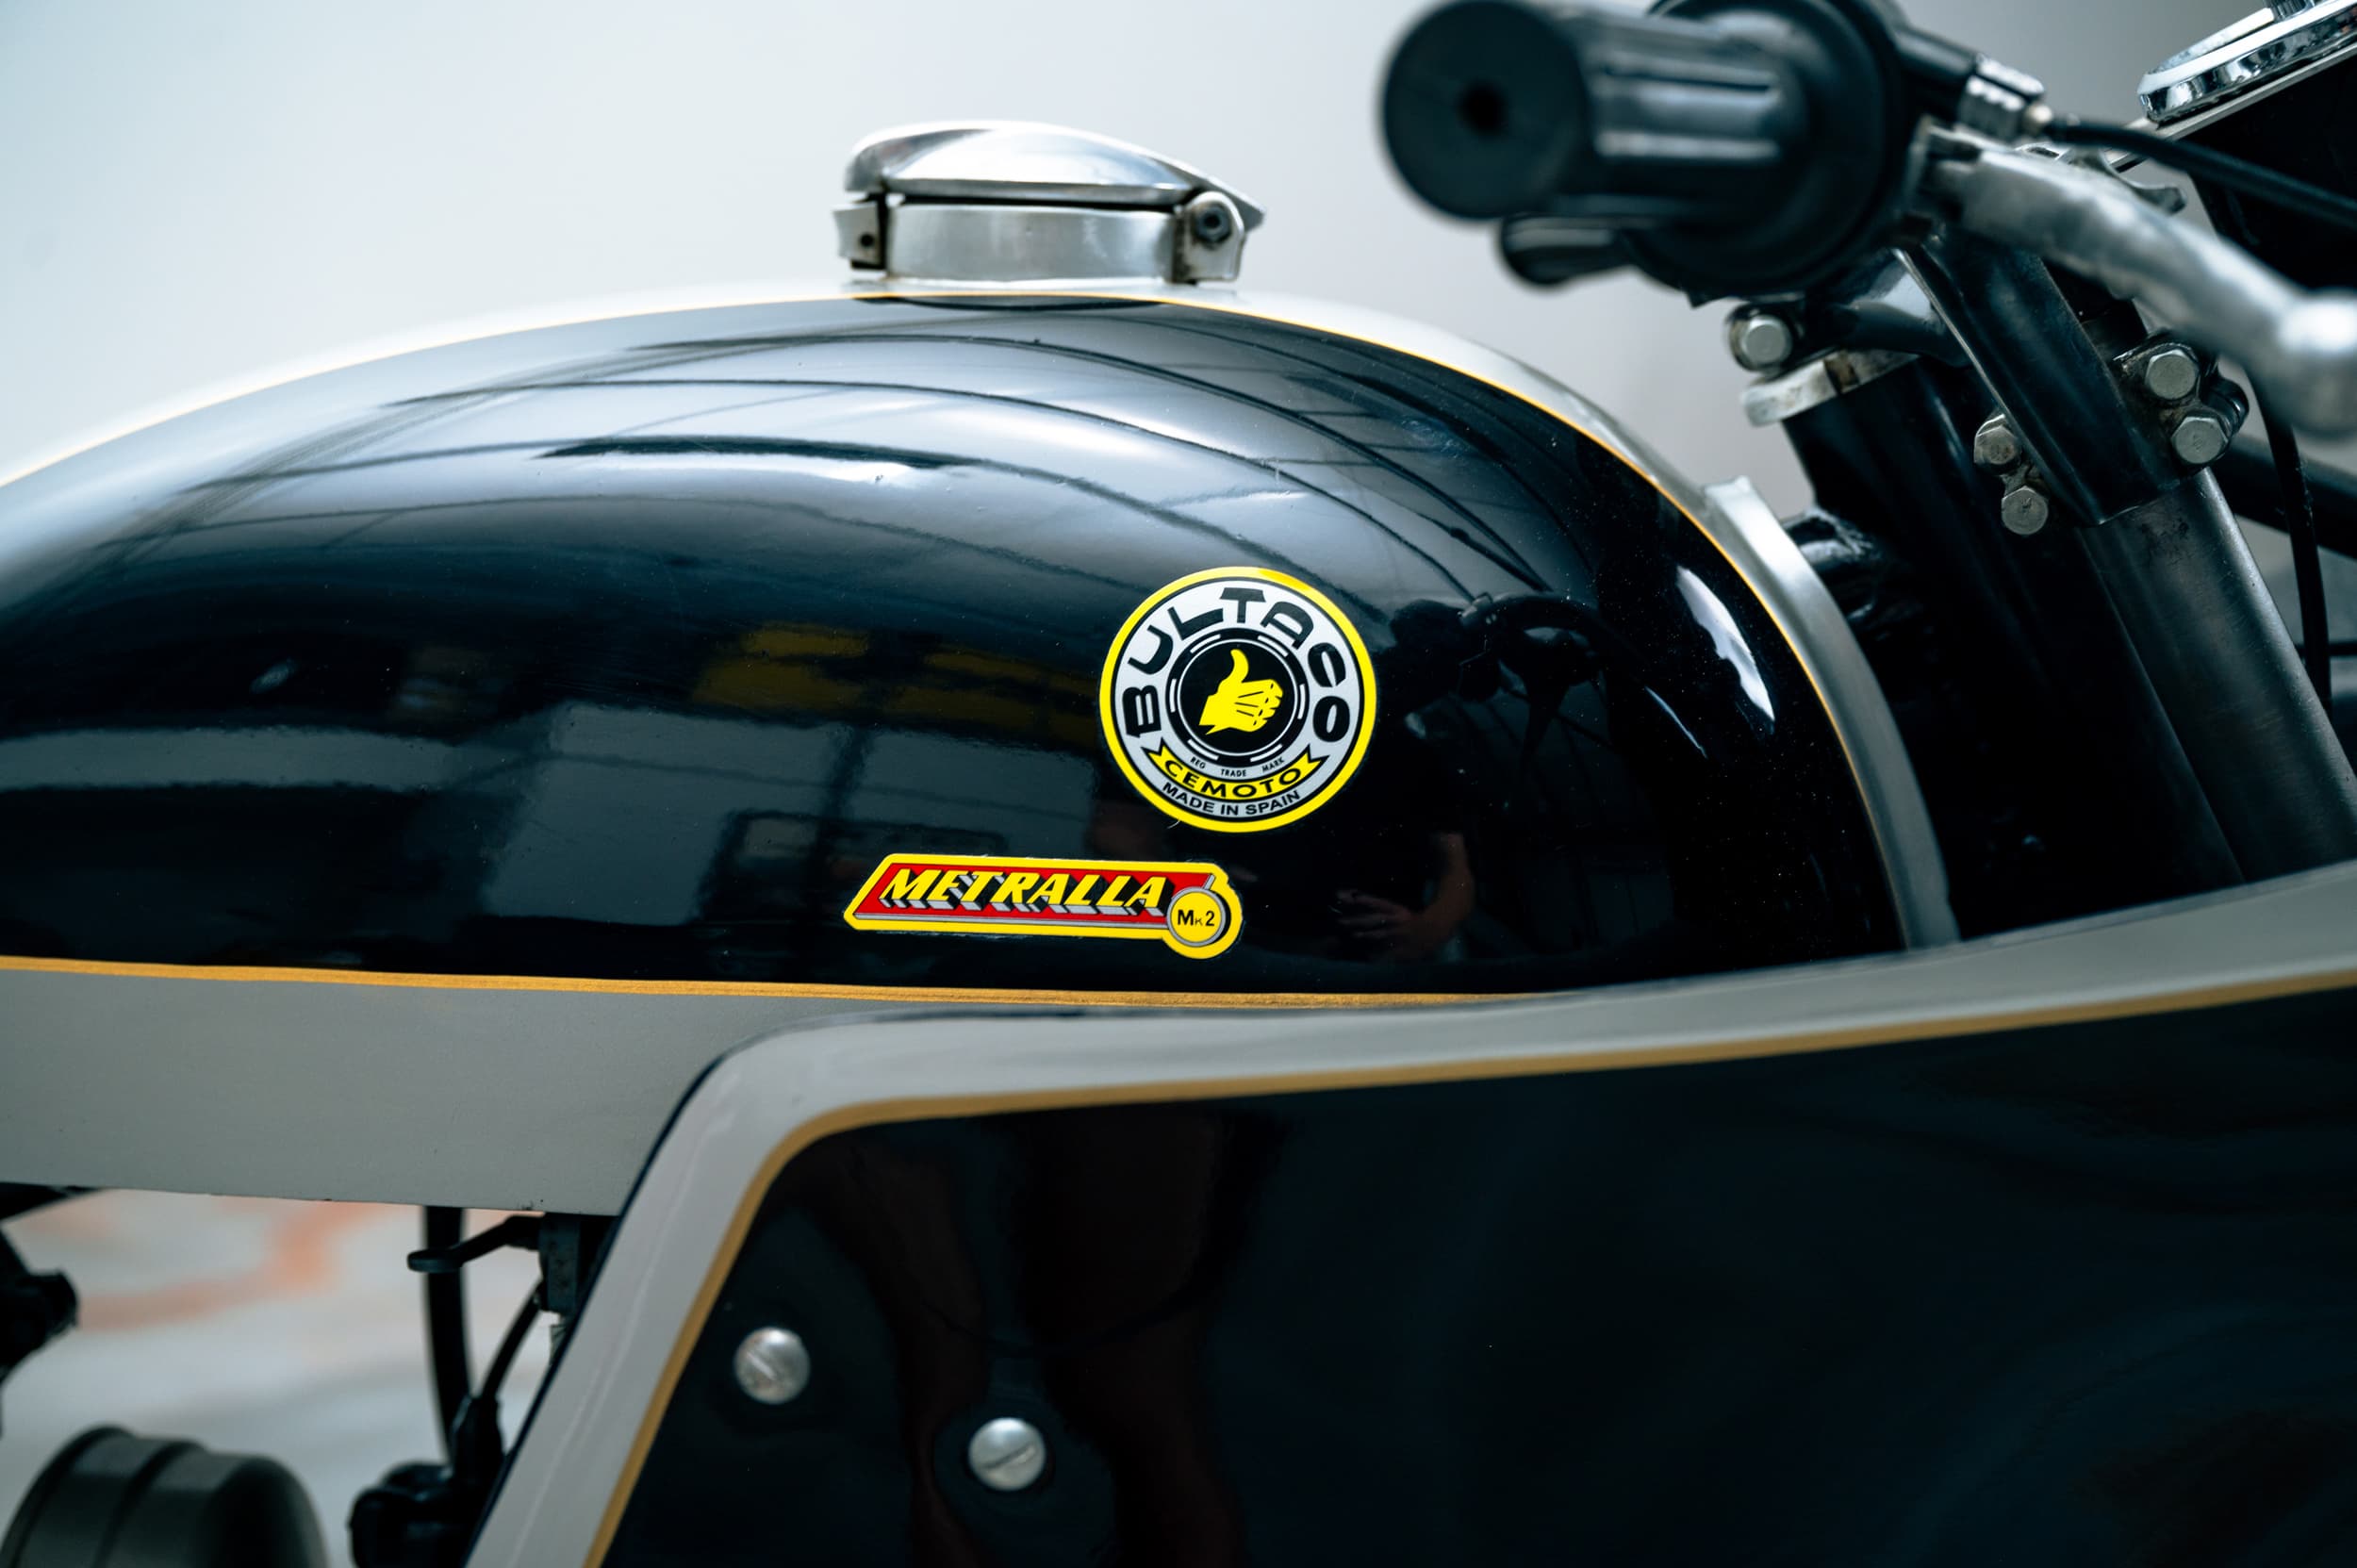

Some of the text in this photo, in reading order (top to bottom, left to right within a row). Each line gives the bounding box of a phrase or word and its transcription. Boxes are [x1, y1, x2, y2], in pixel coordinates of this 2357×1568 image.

[1122, 586, 1350, 743] BULTACO
[1165, 760, 1301, 798] CEMOTO
[1190, 757, 1285, 778] REG TRADE MARK
[1162, 782, 1301, 816] MADE IN SPAIN
[880, 867, 1173, 916] METRALLA
